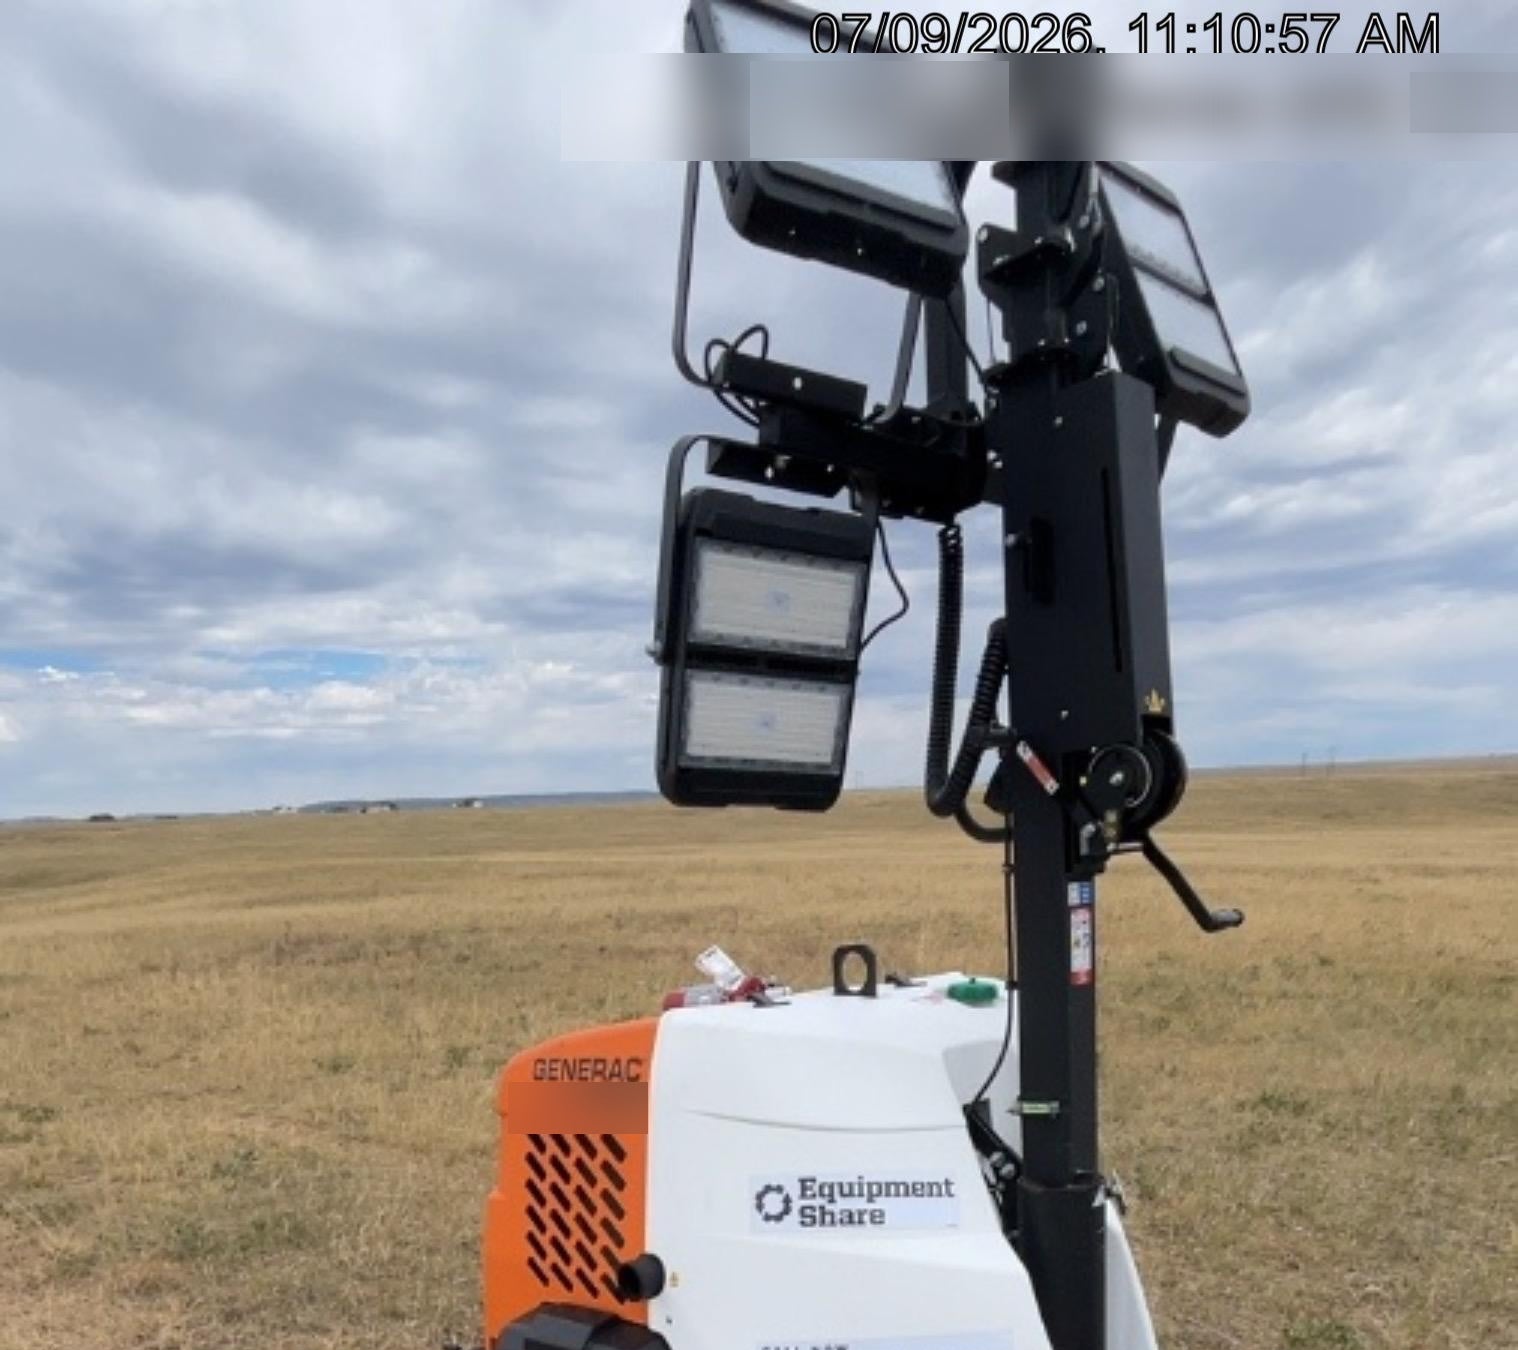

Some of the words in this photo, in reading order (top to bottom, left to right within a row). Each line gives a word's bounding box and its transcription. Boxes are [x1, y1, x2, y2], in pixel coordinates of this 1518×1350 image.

[533, 1057, 642, 1082] GENERAC
[798, 1176, 955, 1203] Equipment
[798, 1205, 886, 1228] Share
